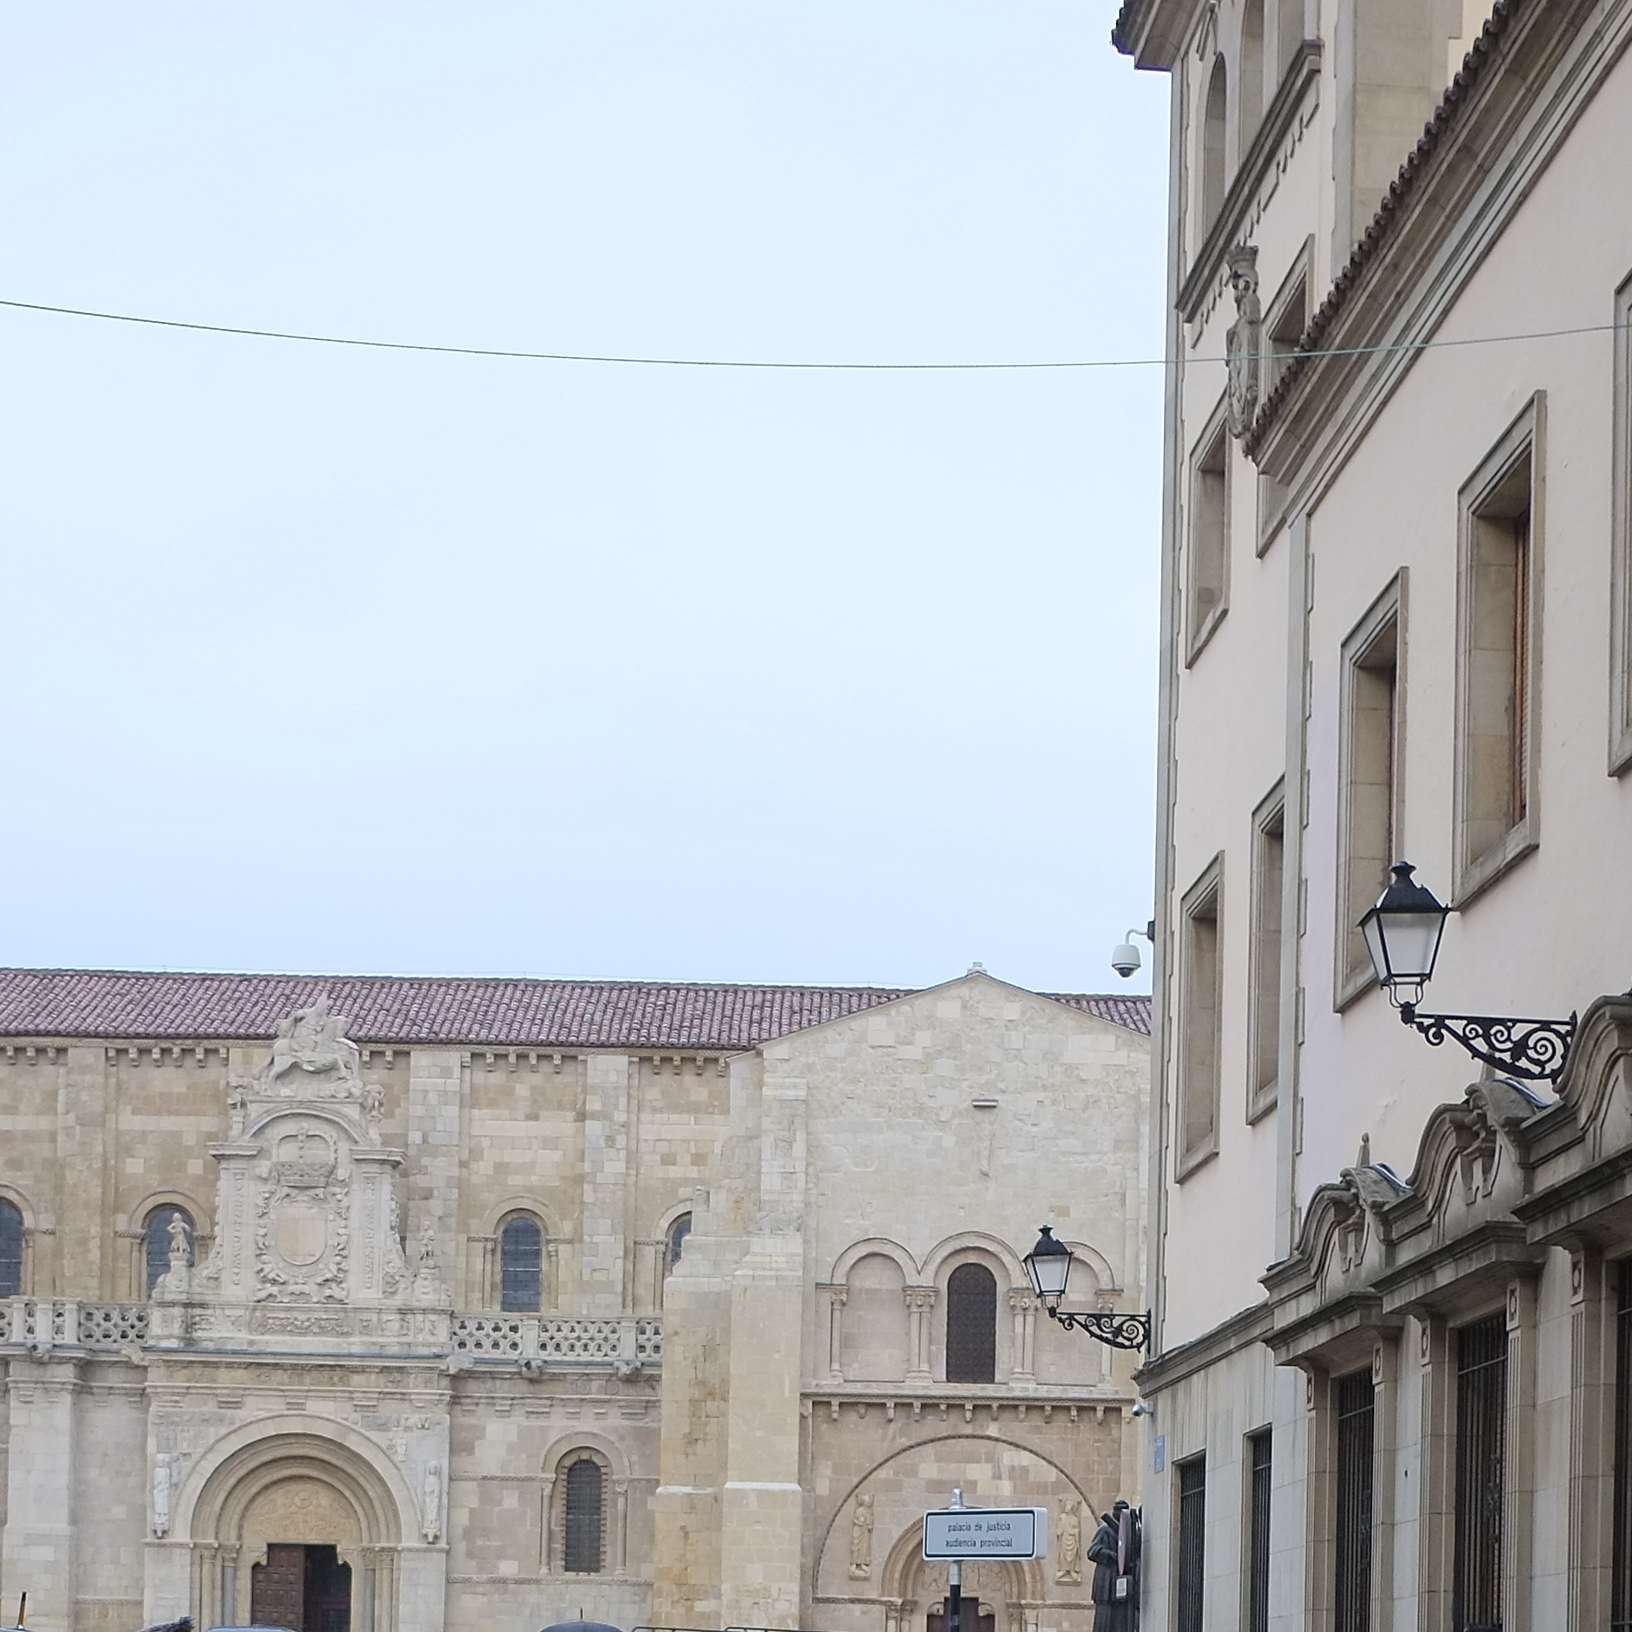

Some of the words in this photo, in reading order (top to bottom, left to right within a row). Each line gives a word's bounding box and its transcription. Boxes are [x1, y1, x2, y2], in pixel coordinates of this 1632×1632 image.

[947, 1521, 971, 1532] palacio
[974, 1522, 983, 1532] de
[986, 1520, 1011, 1533] justicia
[945, 1537, 977, 1548] audiencia
[980, 1537, 1013, 1549] provincial
